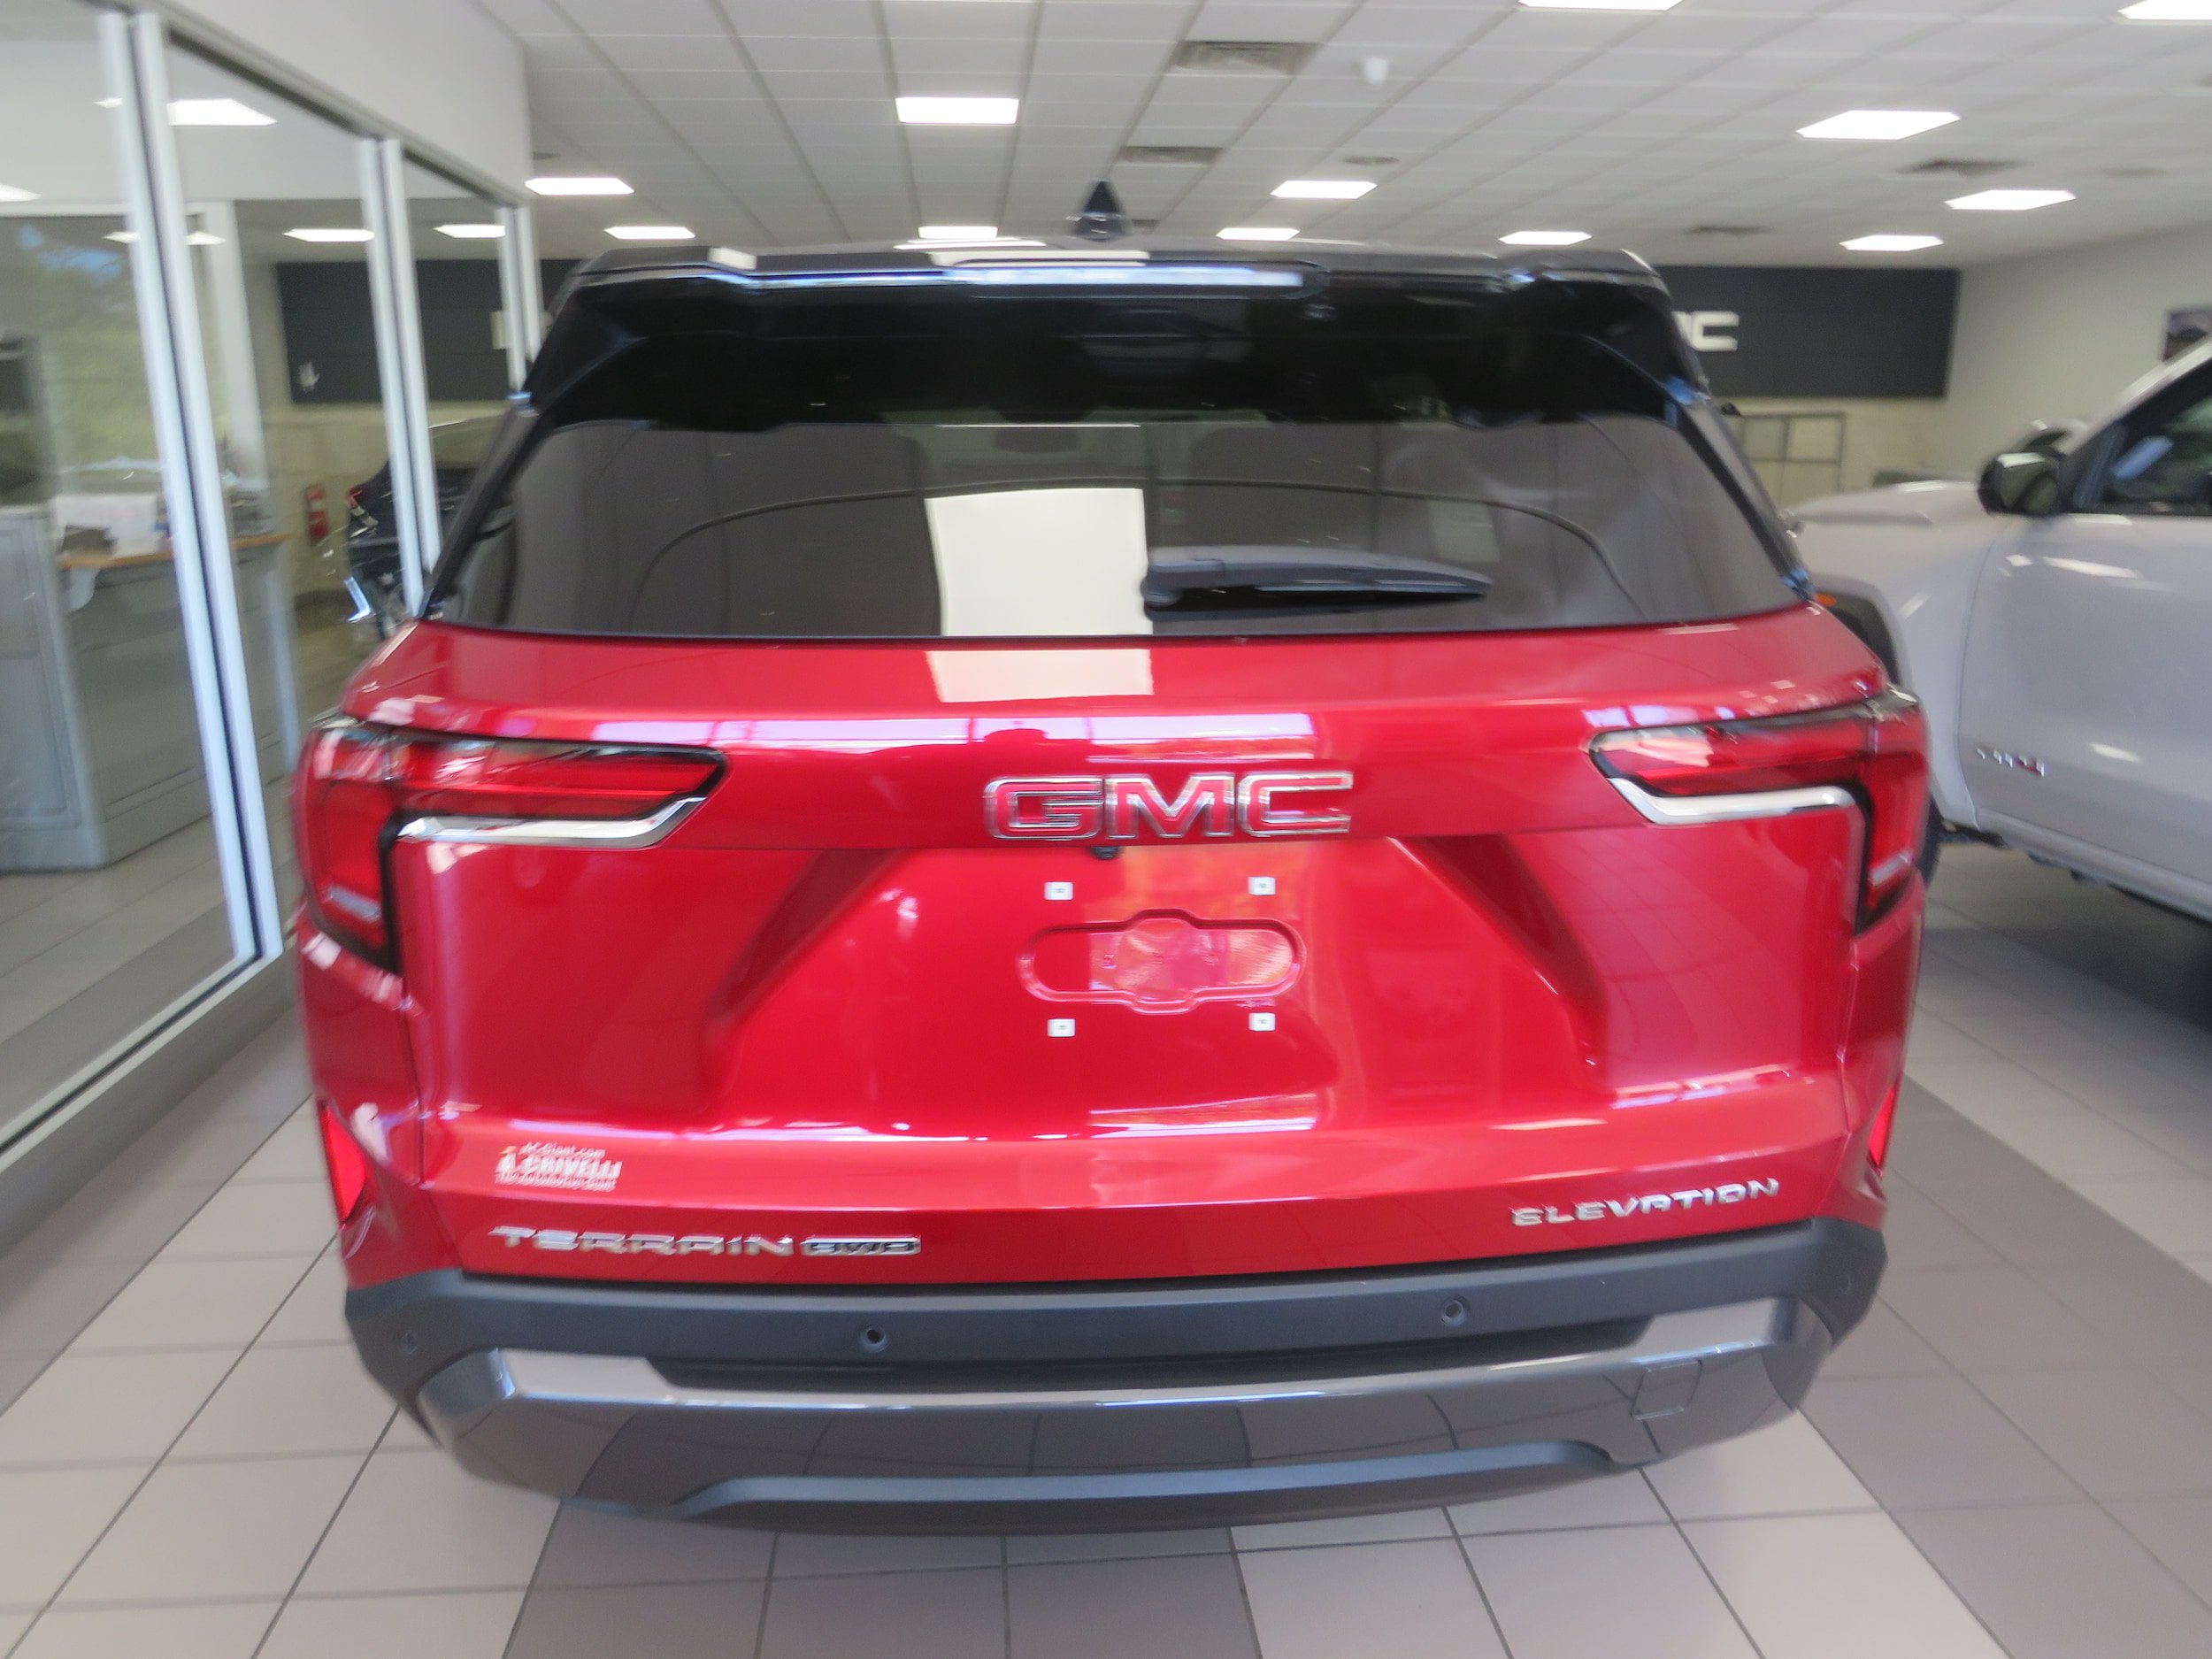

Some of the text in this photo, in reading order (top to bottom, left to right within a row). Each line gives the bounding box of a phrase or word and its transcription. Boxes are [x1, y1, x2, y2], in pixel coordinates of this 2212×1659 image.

[984, 772, 1354, 841] GMC
[1509, 1177, 1779, 1227] ELEVATION
[488, 1225, 794, 1256] TERRAIN
